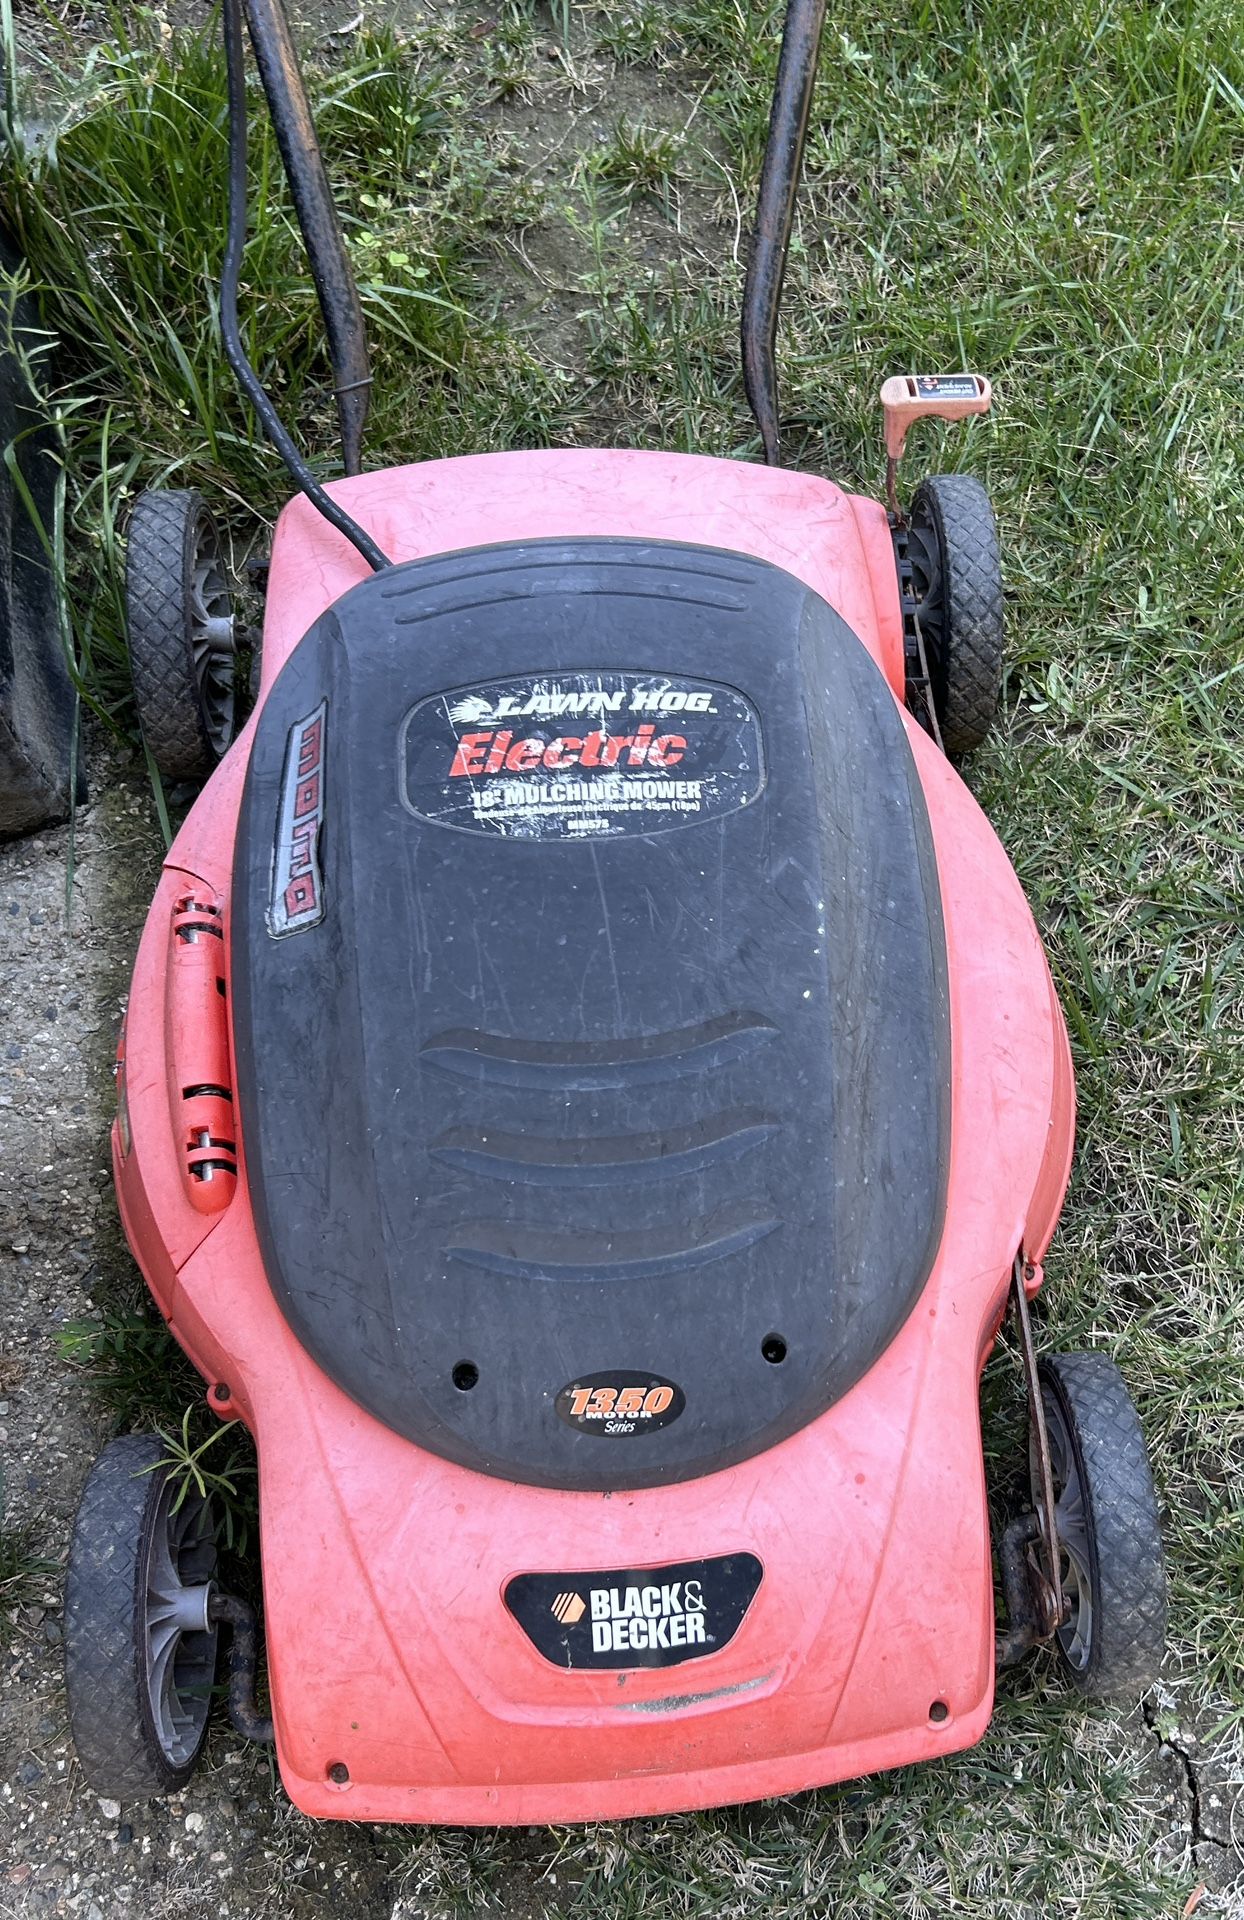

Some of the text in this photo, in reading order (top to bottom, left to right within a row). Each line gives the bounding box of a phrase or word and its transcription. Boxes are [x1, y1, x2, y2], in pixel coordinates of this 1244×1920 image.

[493, 691, 625, 717] LAWN
[448, 724, 687, 777] Electric
[503, 782, 620, 806] MULCHING
[622, 780, 702, 799] MOWER
[570, 1386, 674, 1415] 1350
[585, 1411, 652, 1419] MOTOR
[604, 1420, 636, 1433] Series
[592, 1612, 707, 1652] DECKER
